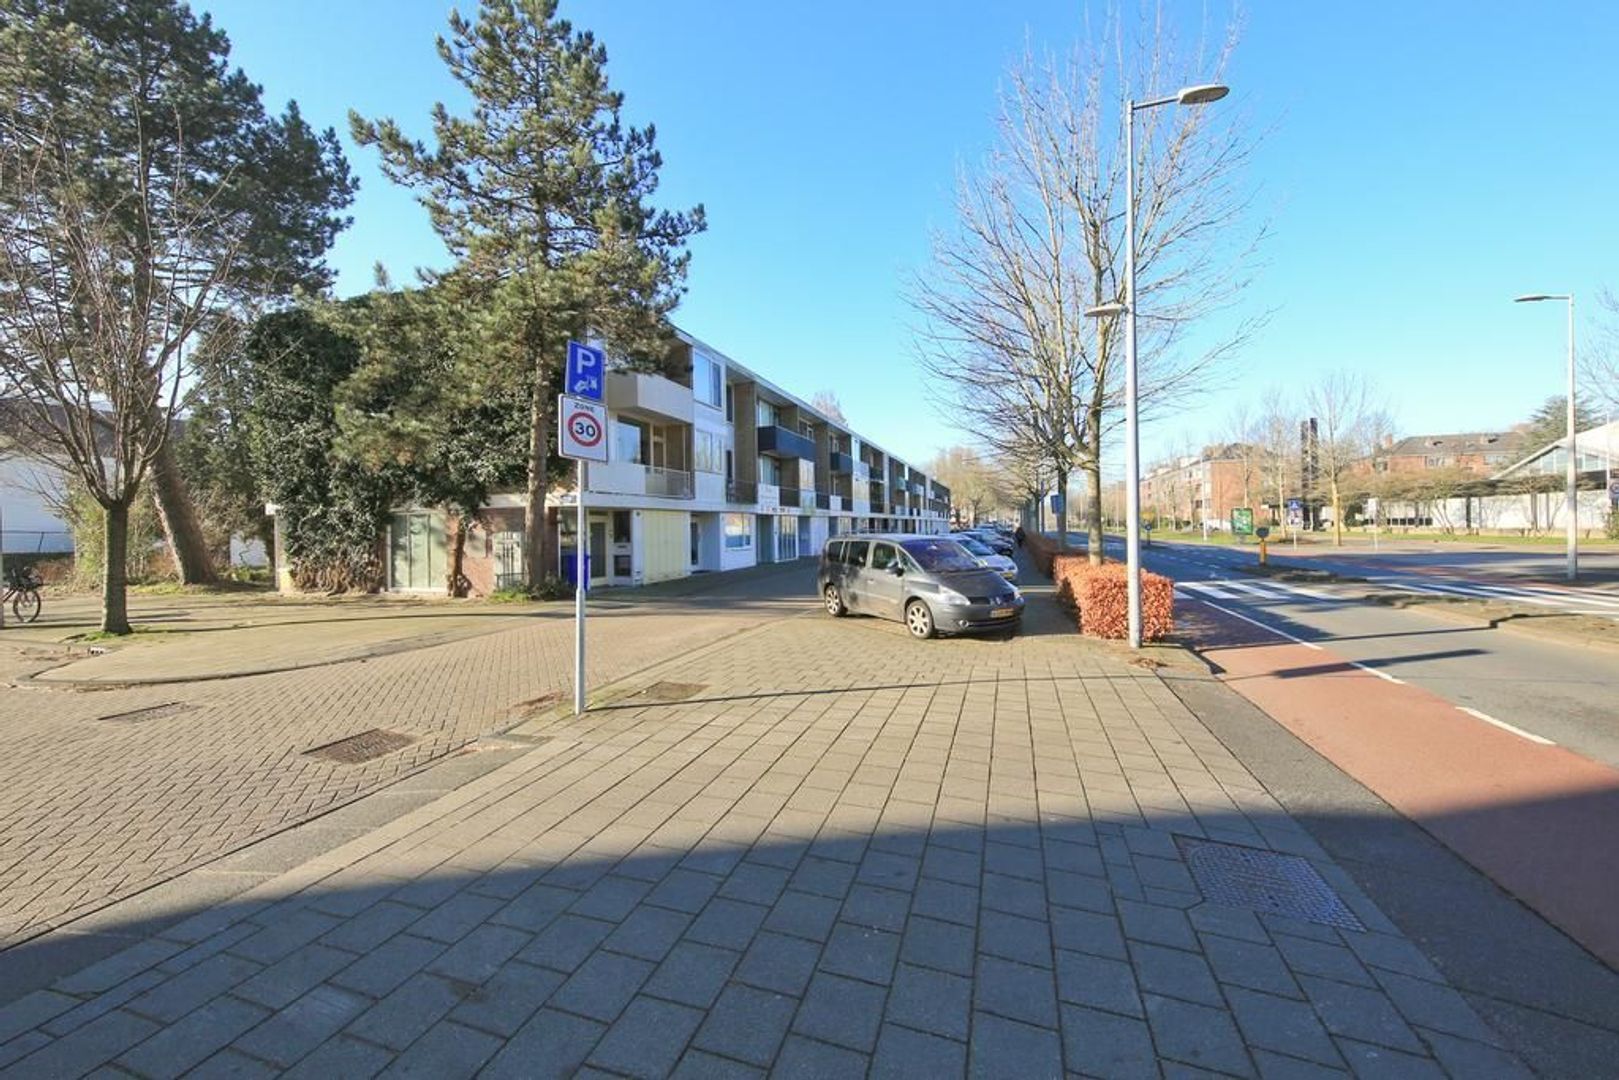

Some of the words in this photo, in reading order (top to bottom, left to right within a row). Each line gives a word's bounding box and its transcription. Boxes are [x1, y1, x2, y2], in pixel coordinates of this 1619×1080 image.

[577, 347, 595, 374] P
[574, 402, 595, 413] ZONE
[575, 422, 595, 437] 30
